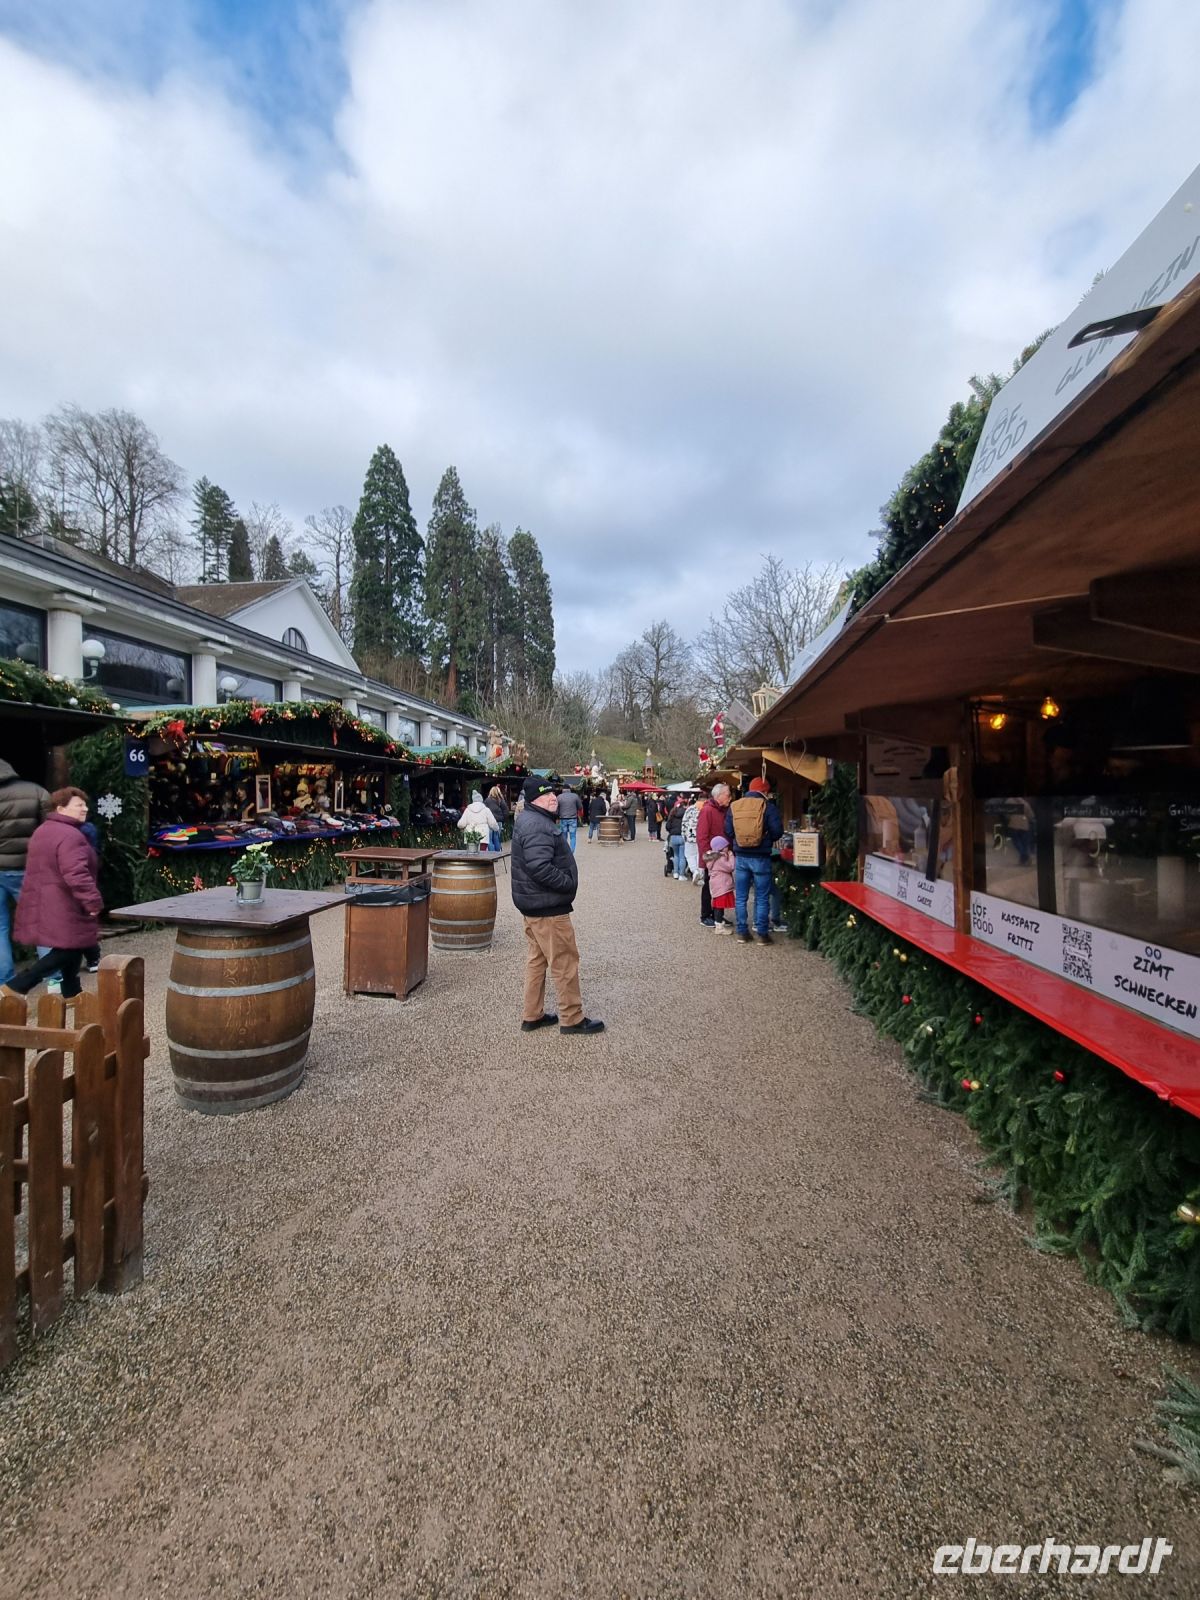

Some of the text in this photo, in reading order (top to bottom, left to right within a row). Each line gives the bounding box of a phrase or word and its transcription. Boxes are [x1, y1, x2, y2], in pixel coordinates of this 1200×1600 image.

[970, 420, 1028, 485] FOOD
[129, 749, 146, 762] 66
[972, 917, 994, 935] FOOD
[1001, 911, 1040, 934] KASSPATZ
[1007, 932, 1034, 951] FRITTI
[1133, 956, 1175, 981] ZIMT
[1114, 975, 1198, 1019] SCHNECKEN
